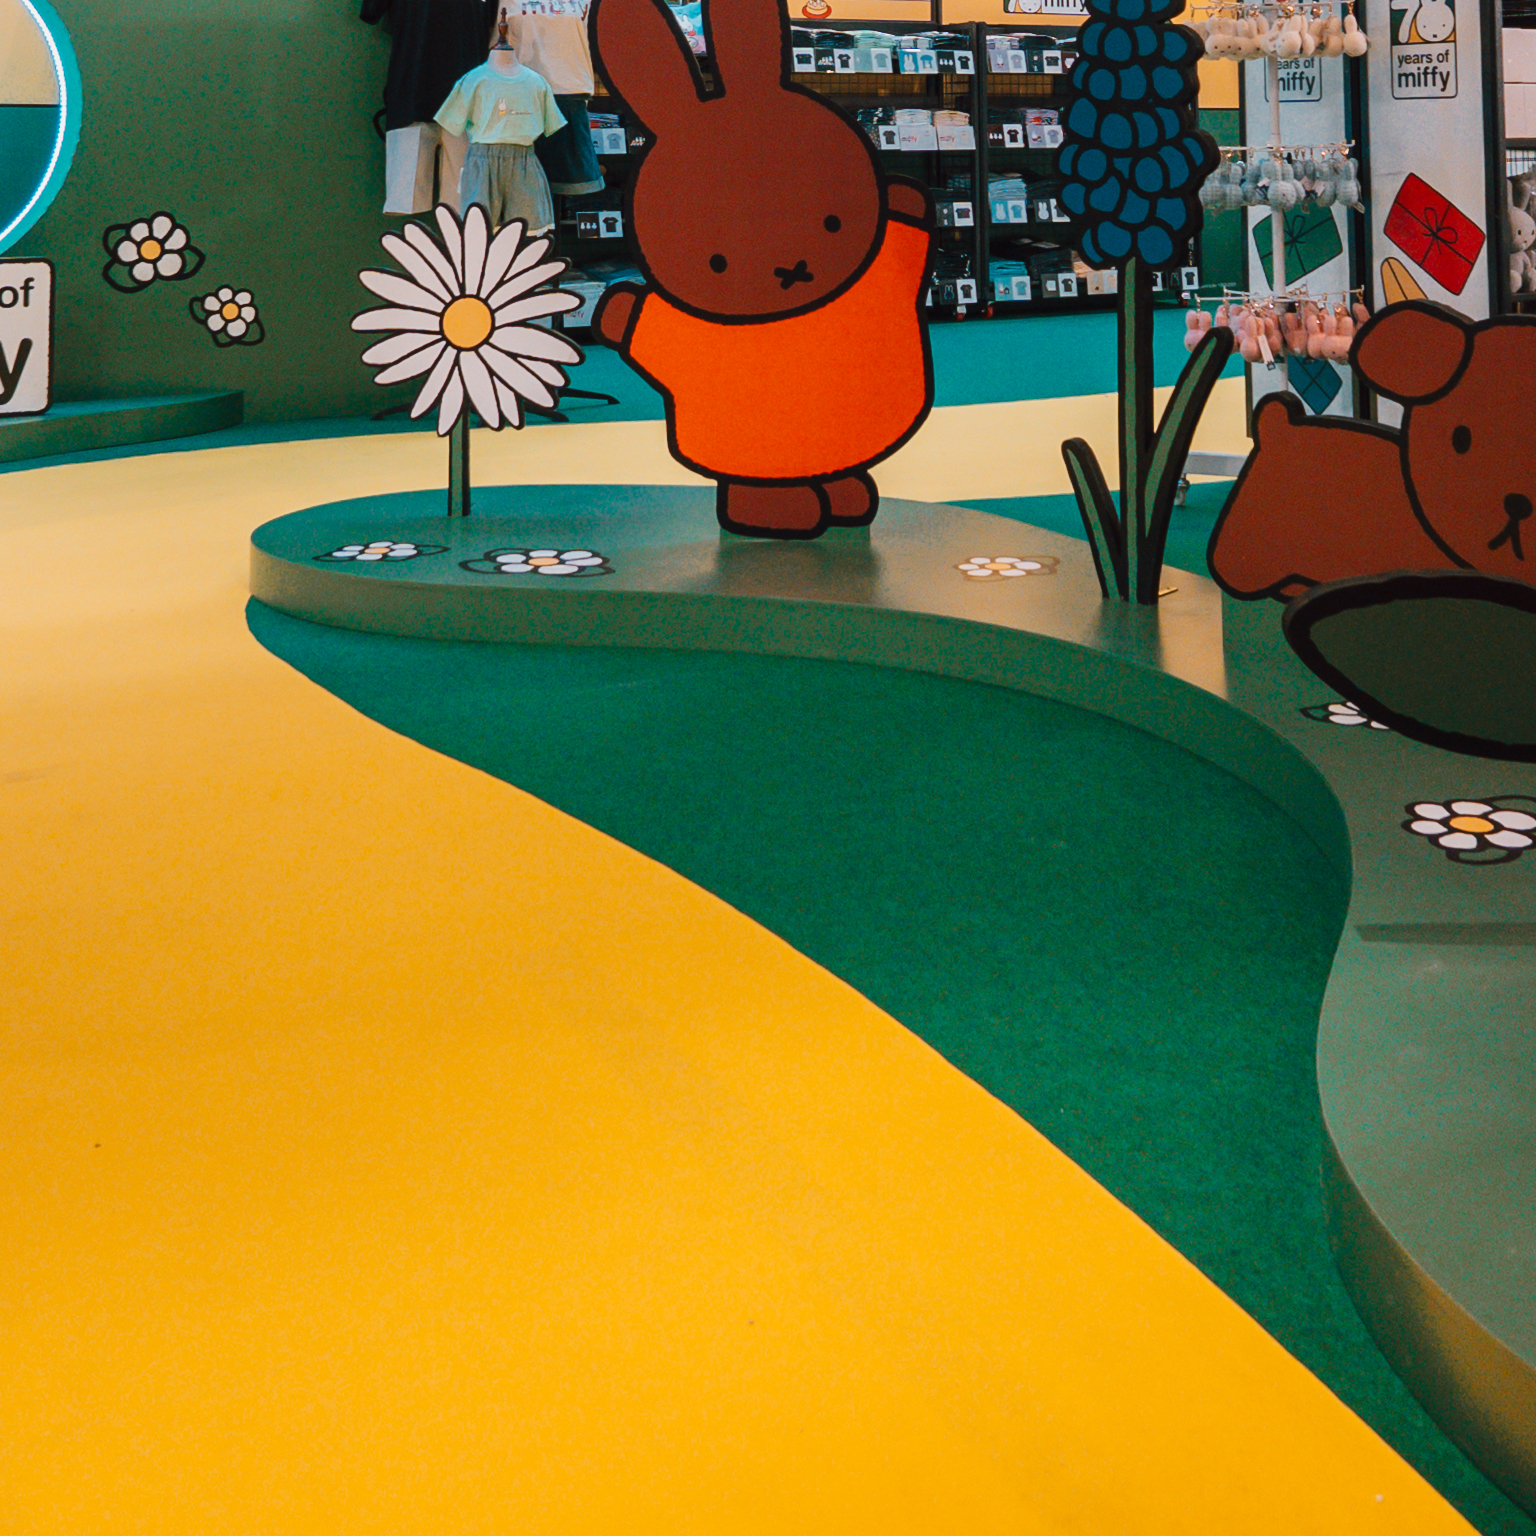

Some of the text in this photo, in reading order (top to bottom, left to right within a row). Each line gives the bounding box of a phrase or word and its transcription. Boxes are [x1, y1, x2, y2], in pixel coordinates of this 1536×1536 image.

[1277, 57, 1315, 70] ears of
[1397, 50, 1450, 68] years of
[1397, 66, 1450, 92] miffy
